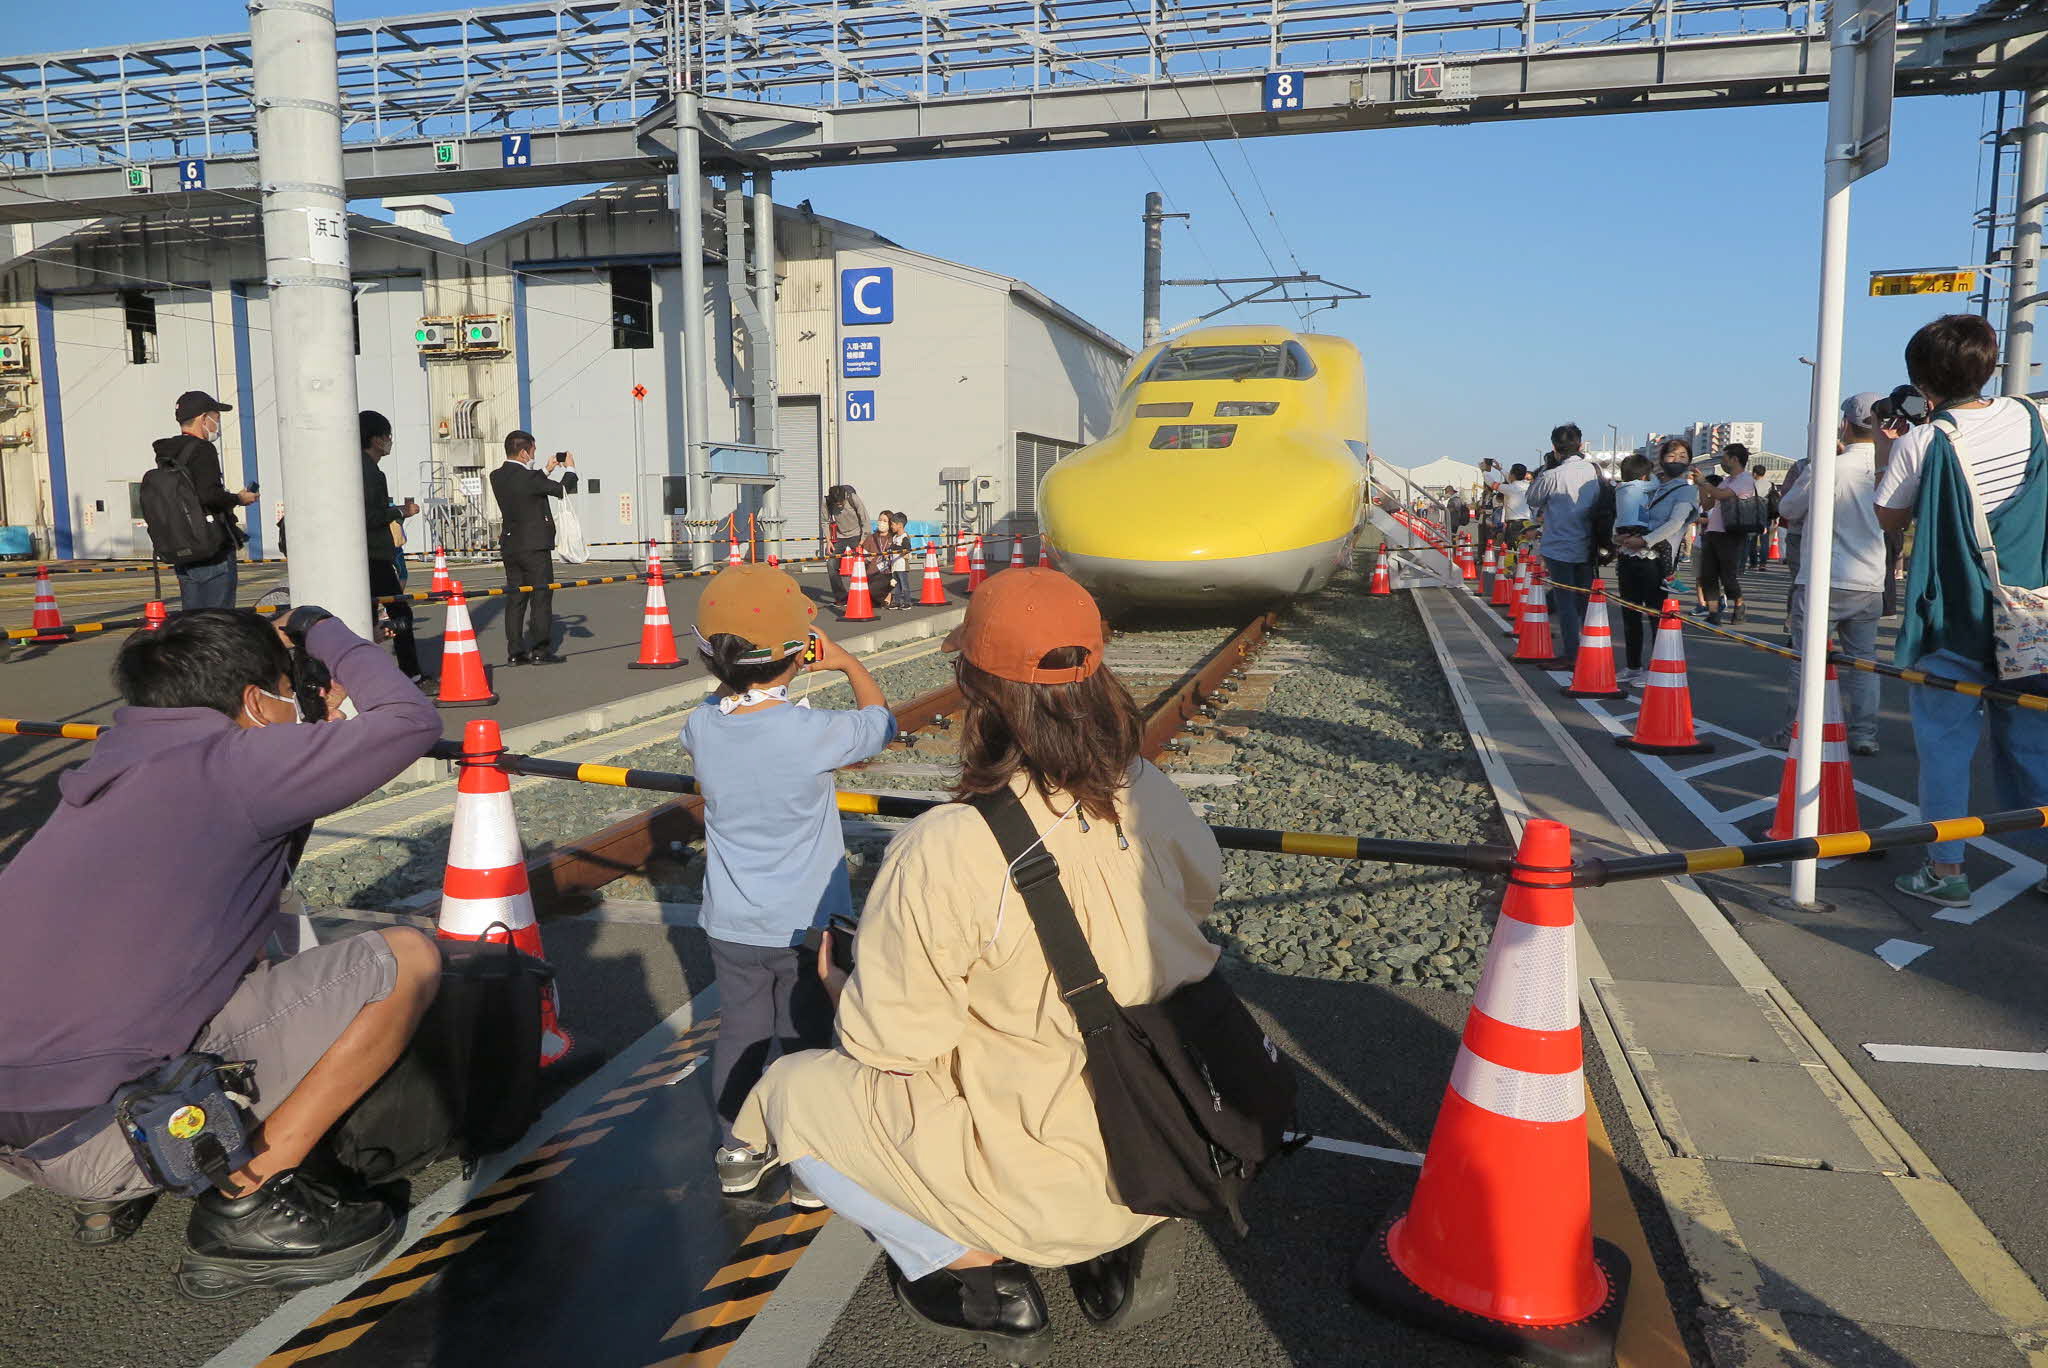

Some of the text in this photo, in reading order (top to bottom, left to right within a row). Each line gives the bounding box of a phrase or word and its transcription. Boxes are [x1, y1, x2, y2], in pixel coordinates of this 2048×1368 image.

[1277, 74, 1292, 96] 8
[1418, 67, 1440, 89] 入
[438, 145, 452, 163] 切
[510, 135, 521, 155] 7
[187, 161, 197, 179] 6
[853, 275, 882, 316] C
[1926, 281, 1952, 293] 4.5
[1958, 282, 1968, 291] m
[847, 393, 855, 402] C
[849, 402, 871, 419] 01
